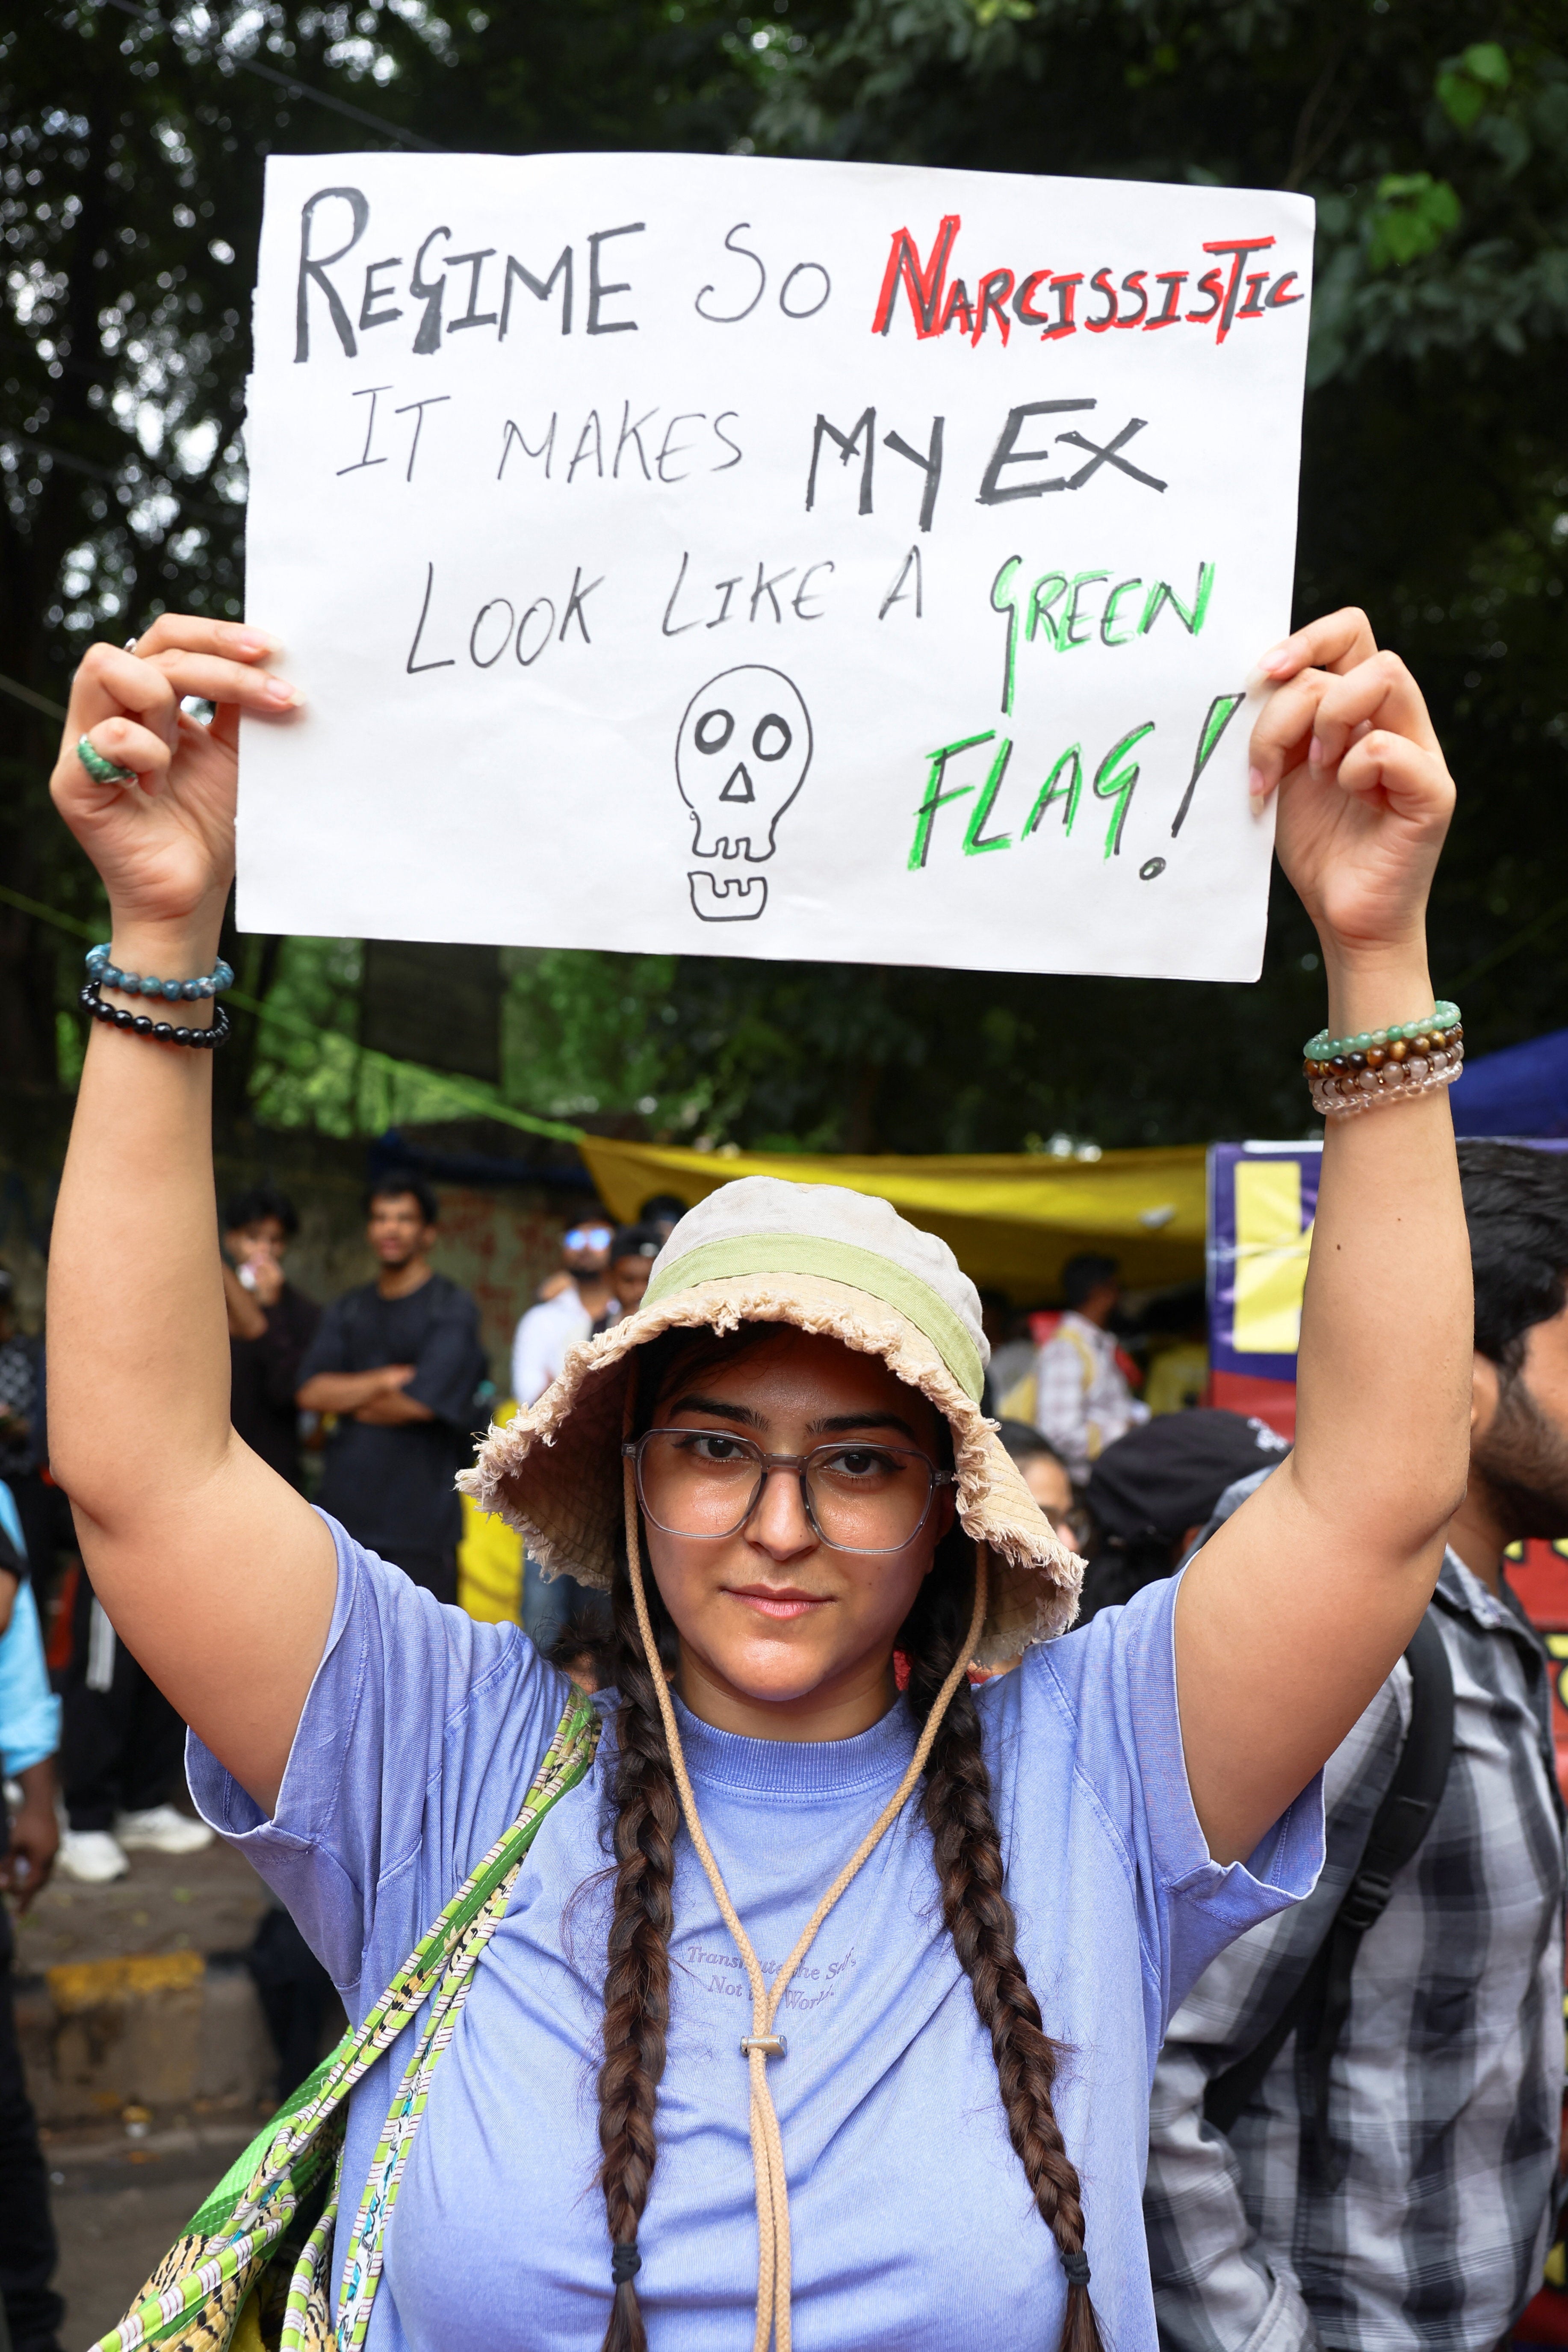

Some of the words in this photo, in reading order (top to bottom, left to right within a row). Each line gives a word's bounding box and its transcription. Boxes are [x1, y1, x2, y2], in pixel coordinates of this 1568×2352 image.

[293, 187, 646, 363] REGIME
[871, 214, 1304, 346] NARCISSISTIC
[336, 386, 451, 482] IT
[497, 400, 742, 483] MAKES
[406, 562, 603, 674] LOOK
[662, 551, 835, 636] LIKE
[878, 545, 922, 621] A
[990, 555, 1215, 716] GREEN
[907, 692, 1246, 881] FLAG!
[708, 1974, 742, 1997] Not
